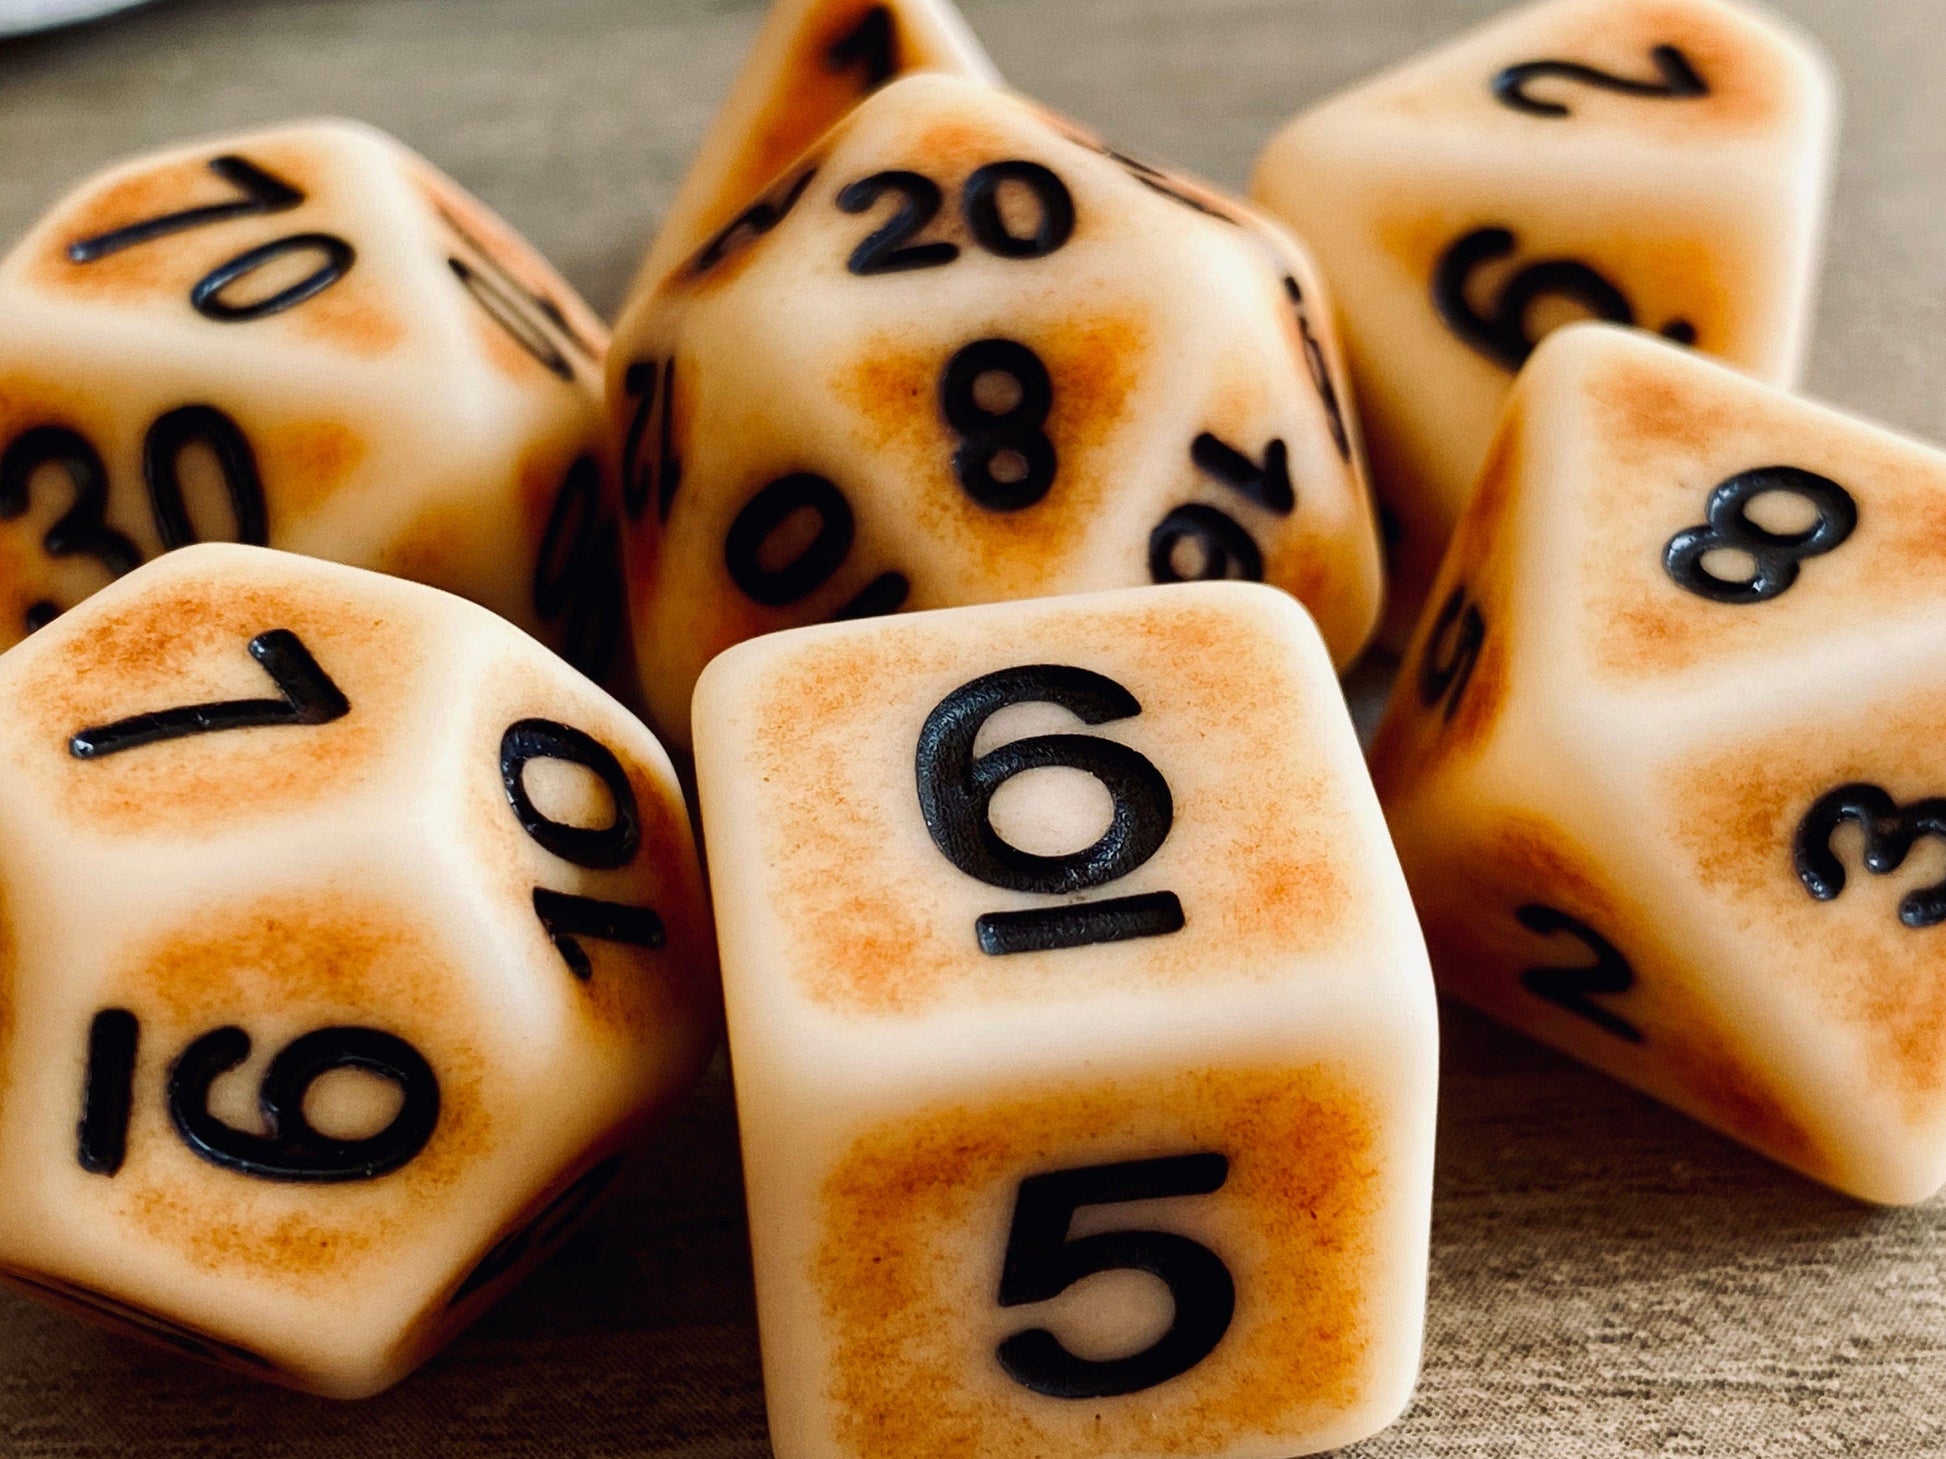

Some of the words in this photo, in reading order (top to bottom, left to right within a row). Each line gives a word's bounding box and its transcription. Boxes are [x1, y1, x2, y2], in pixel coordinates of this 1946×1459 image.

[1492, 45, 1708, 118] 2
[837, 160, 1077, 275] 20
[940, 338, 1058, 512] 8
[1662, 466, 1858, 604] 8
[500, 717, 667, 982] 10
[915, 664, 1187, 957] 6
[1793, 782, 1946, 928] 3
[1516, 904, 1646, 1046] 2
[995, 1152, 1237, 1399] 5
